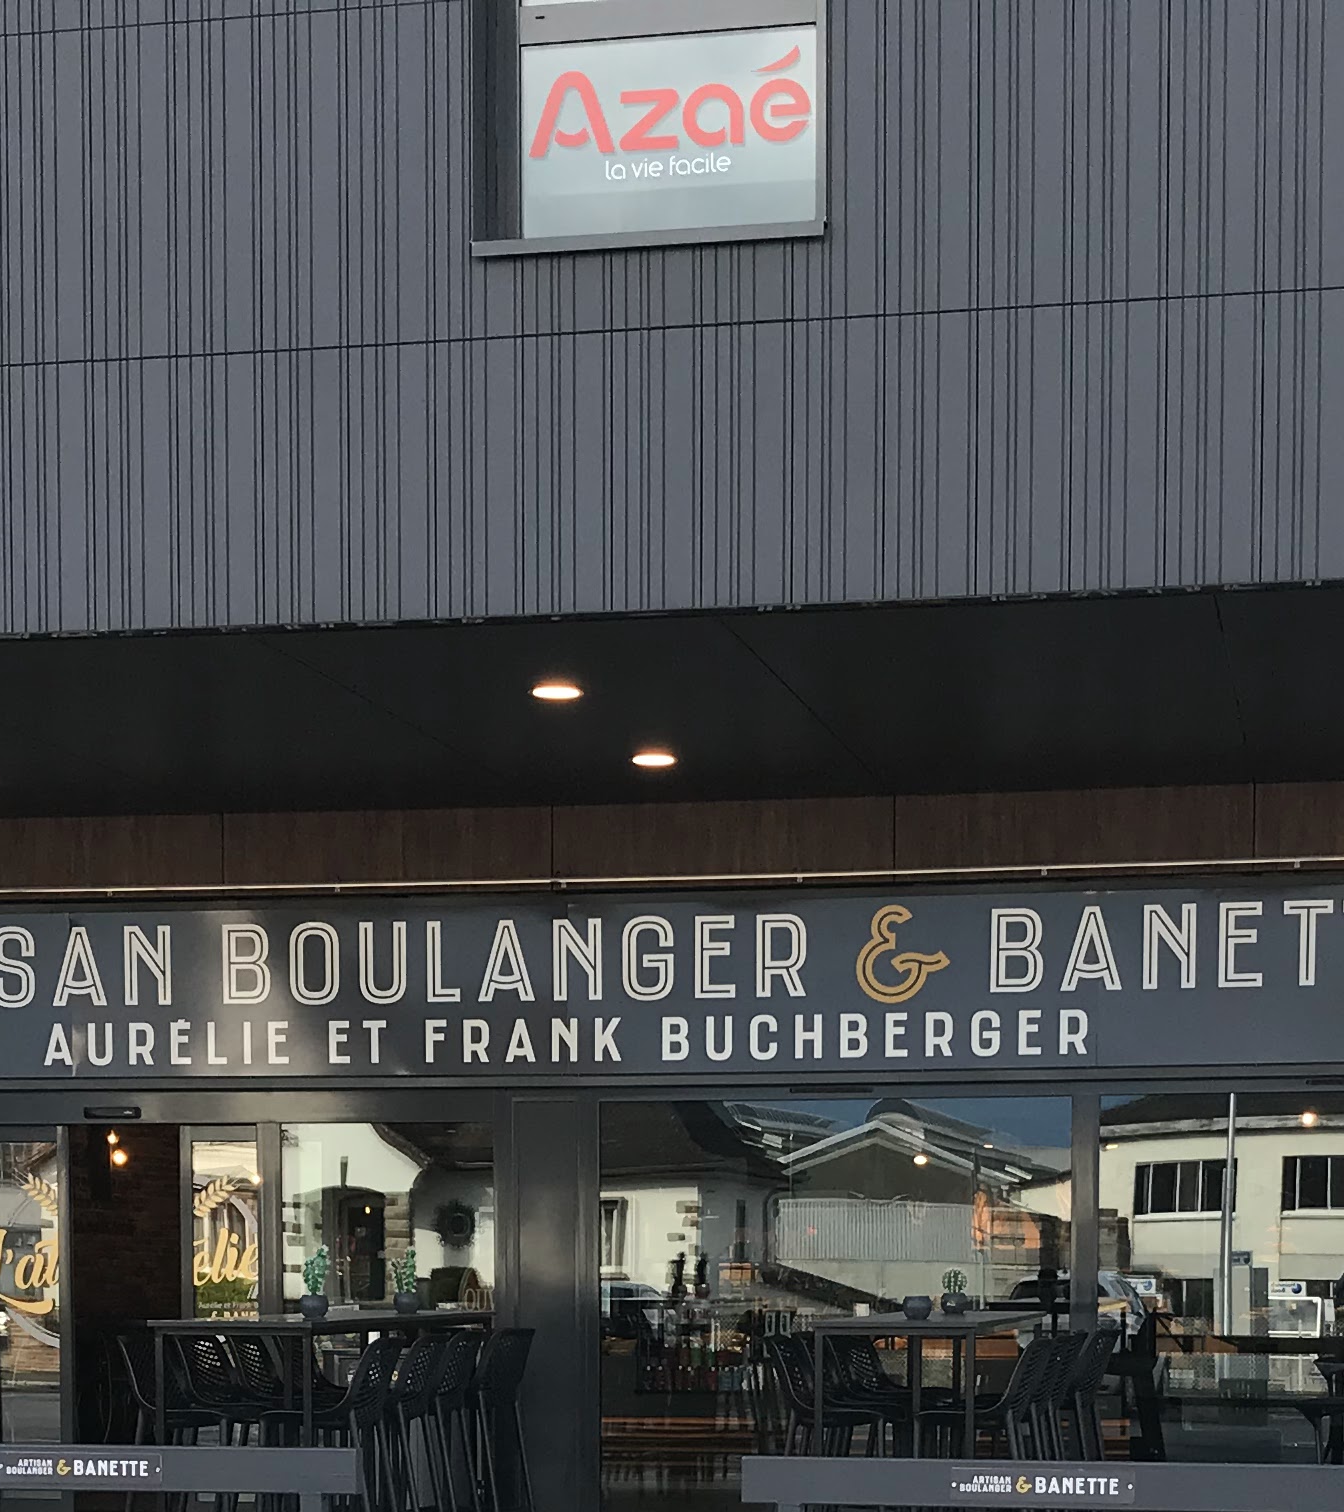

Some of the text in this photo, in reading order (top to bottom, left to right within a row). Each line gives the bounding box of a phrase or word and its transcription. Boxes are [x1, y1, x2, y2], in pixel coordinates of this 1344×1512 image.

[529, 45, 811, 158] Azaé
[605, 152, 731, 180] la vie facile
[221, 914, 806, 1006] BOULANGER
[857, 904, 950, 1005] &
[44, 1009, 1088, 1066] AURÉLIE ET FRANK BUCHBERGER
[6, 1459, 148, 1477] BOULANGER & BANETTE
[17, 1458, 53, 1467] ARTISAN
[959, 1475, 1119, 1495] BOULANGER & BANETTE
[972, 1475, 1012, 1484] ARTISAN
